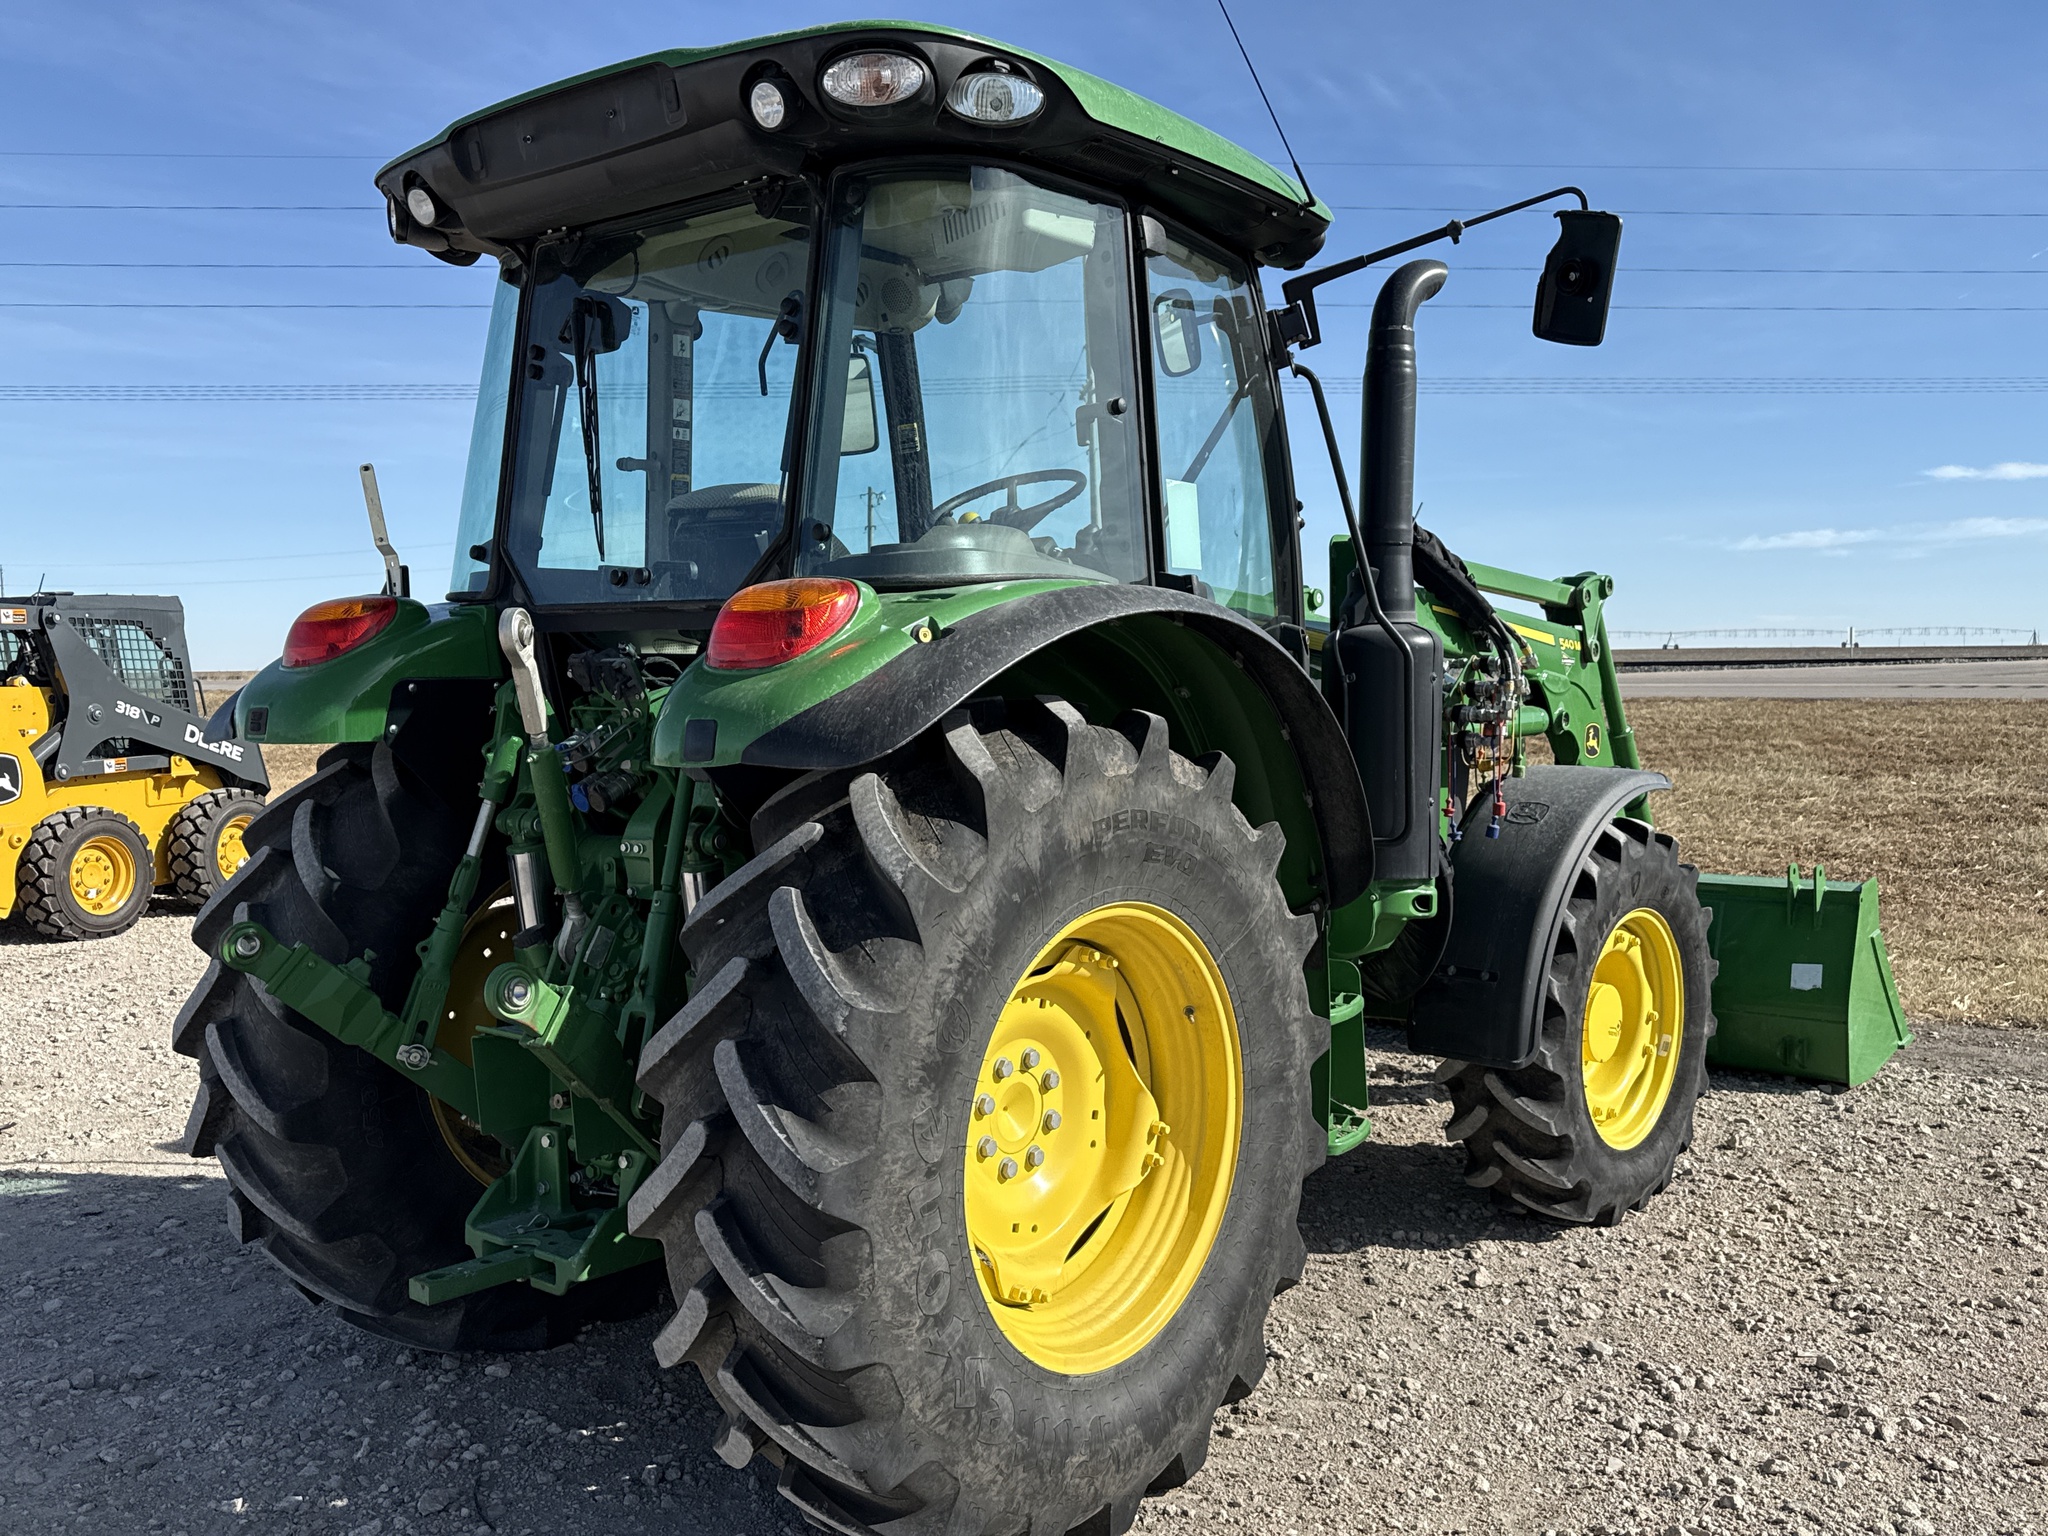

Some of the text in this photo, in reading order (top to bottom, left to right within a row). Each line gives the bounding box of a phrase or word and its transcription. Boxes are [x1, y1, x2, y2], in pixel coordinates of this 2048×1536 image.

[114, 700, 161, 724] 318 P
[1143, 841, 1198, 877] EVO
